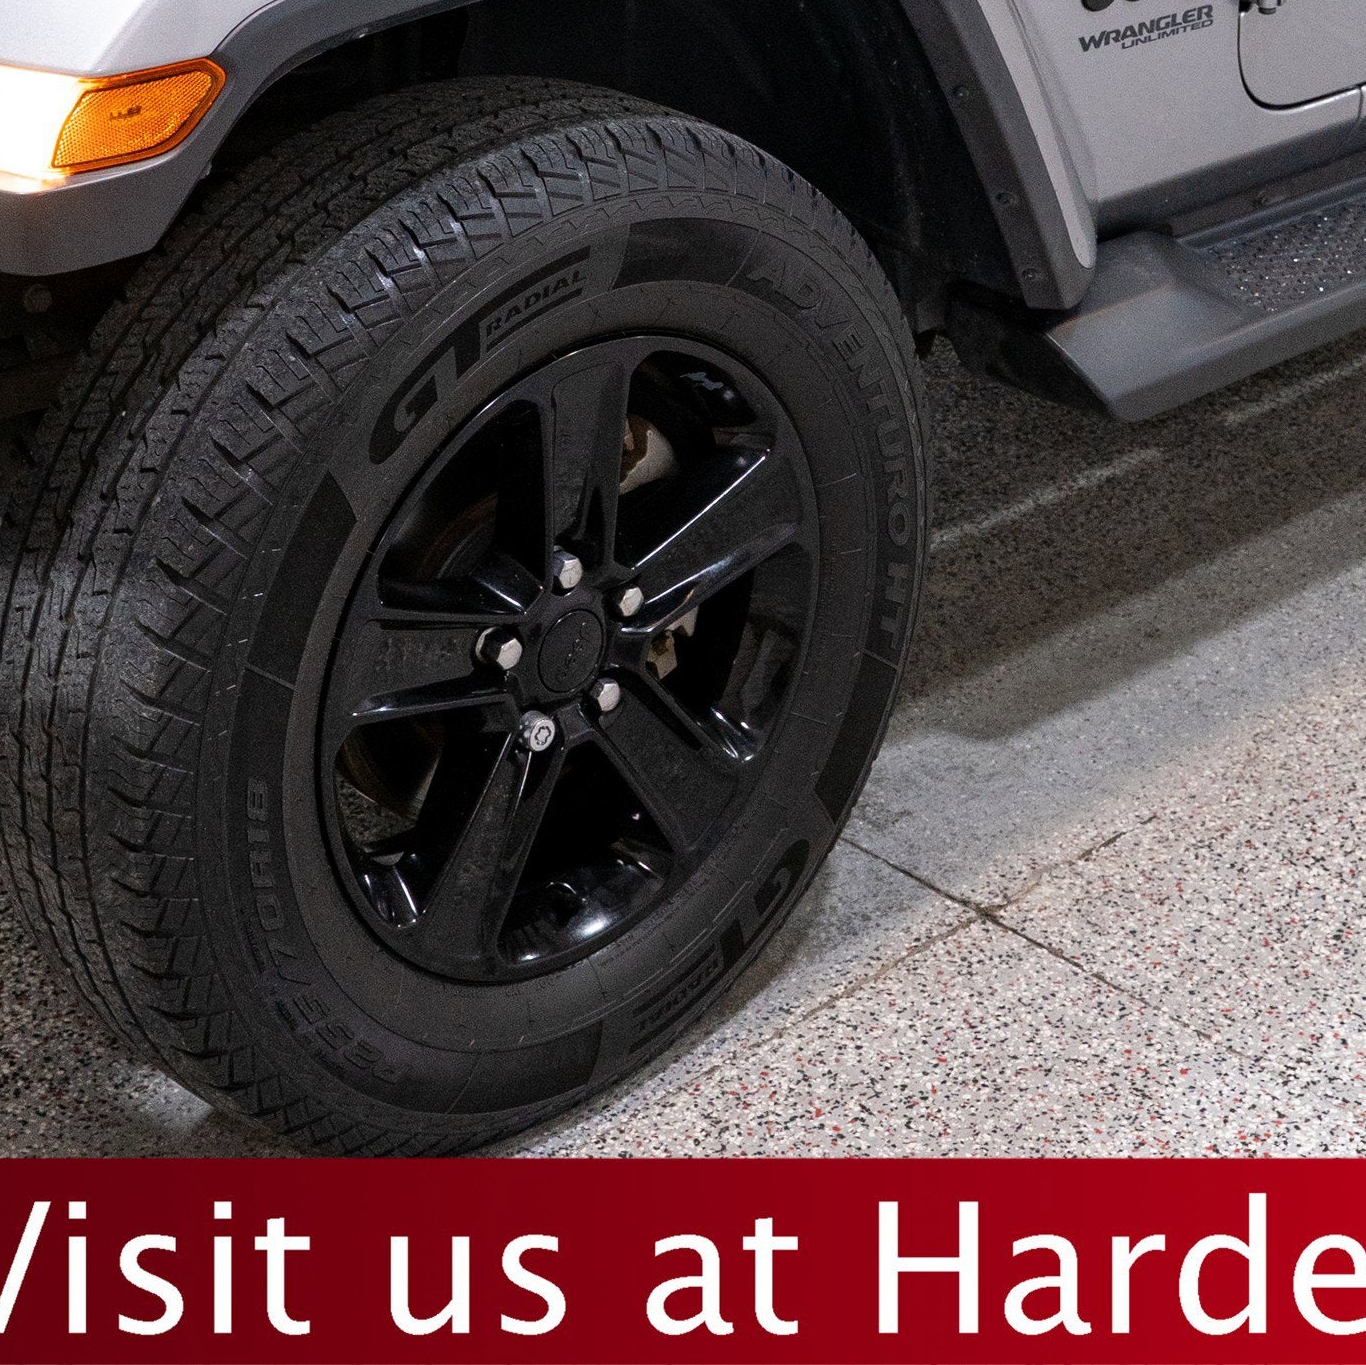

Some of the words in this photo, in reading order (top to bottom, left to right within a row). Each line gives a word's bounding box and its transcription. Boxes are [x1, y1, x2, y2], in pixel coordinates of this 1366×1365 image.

[1079, 5, 1214, 52] WRANGLER
[1121, 19, 1214, 49] UNLIMITED
[486, 271, 587, 337] RADIAL
[747, 258, 912, 547] ADVENTURO
